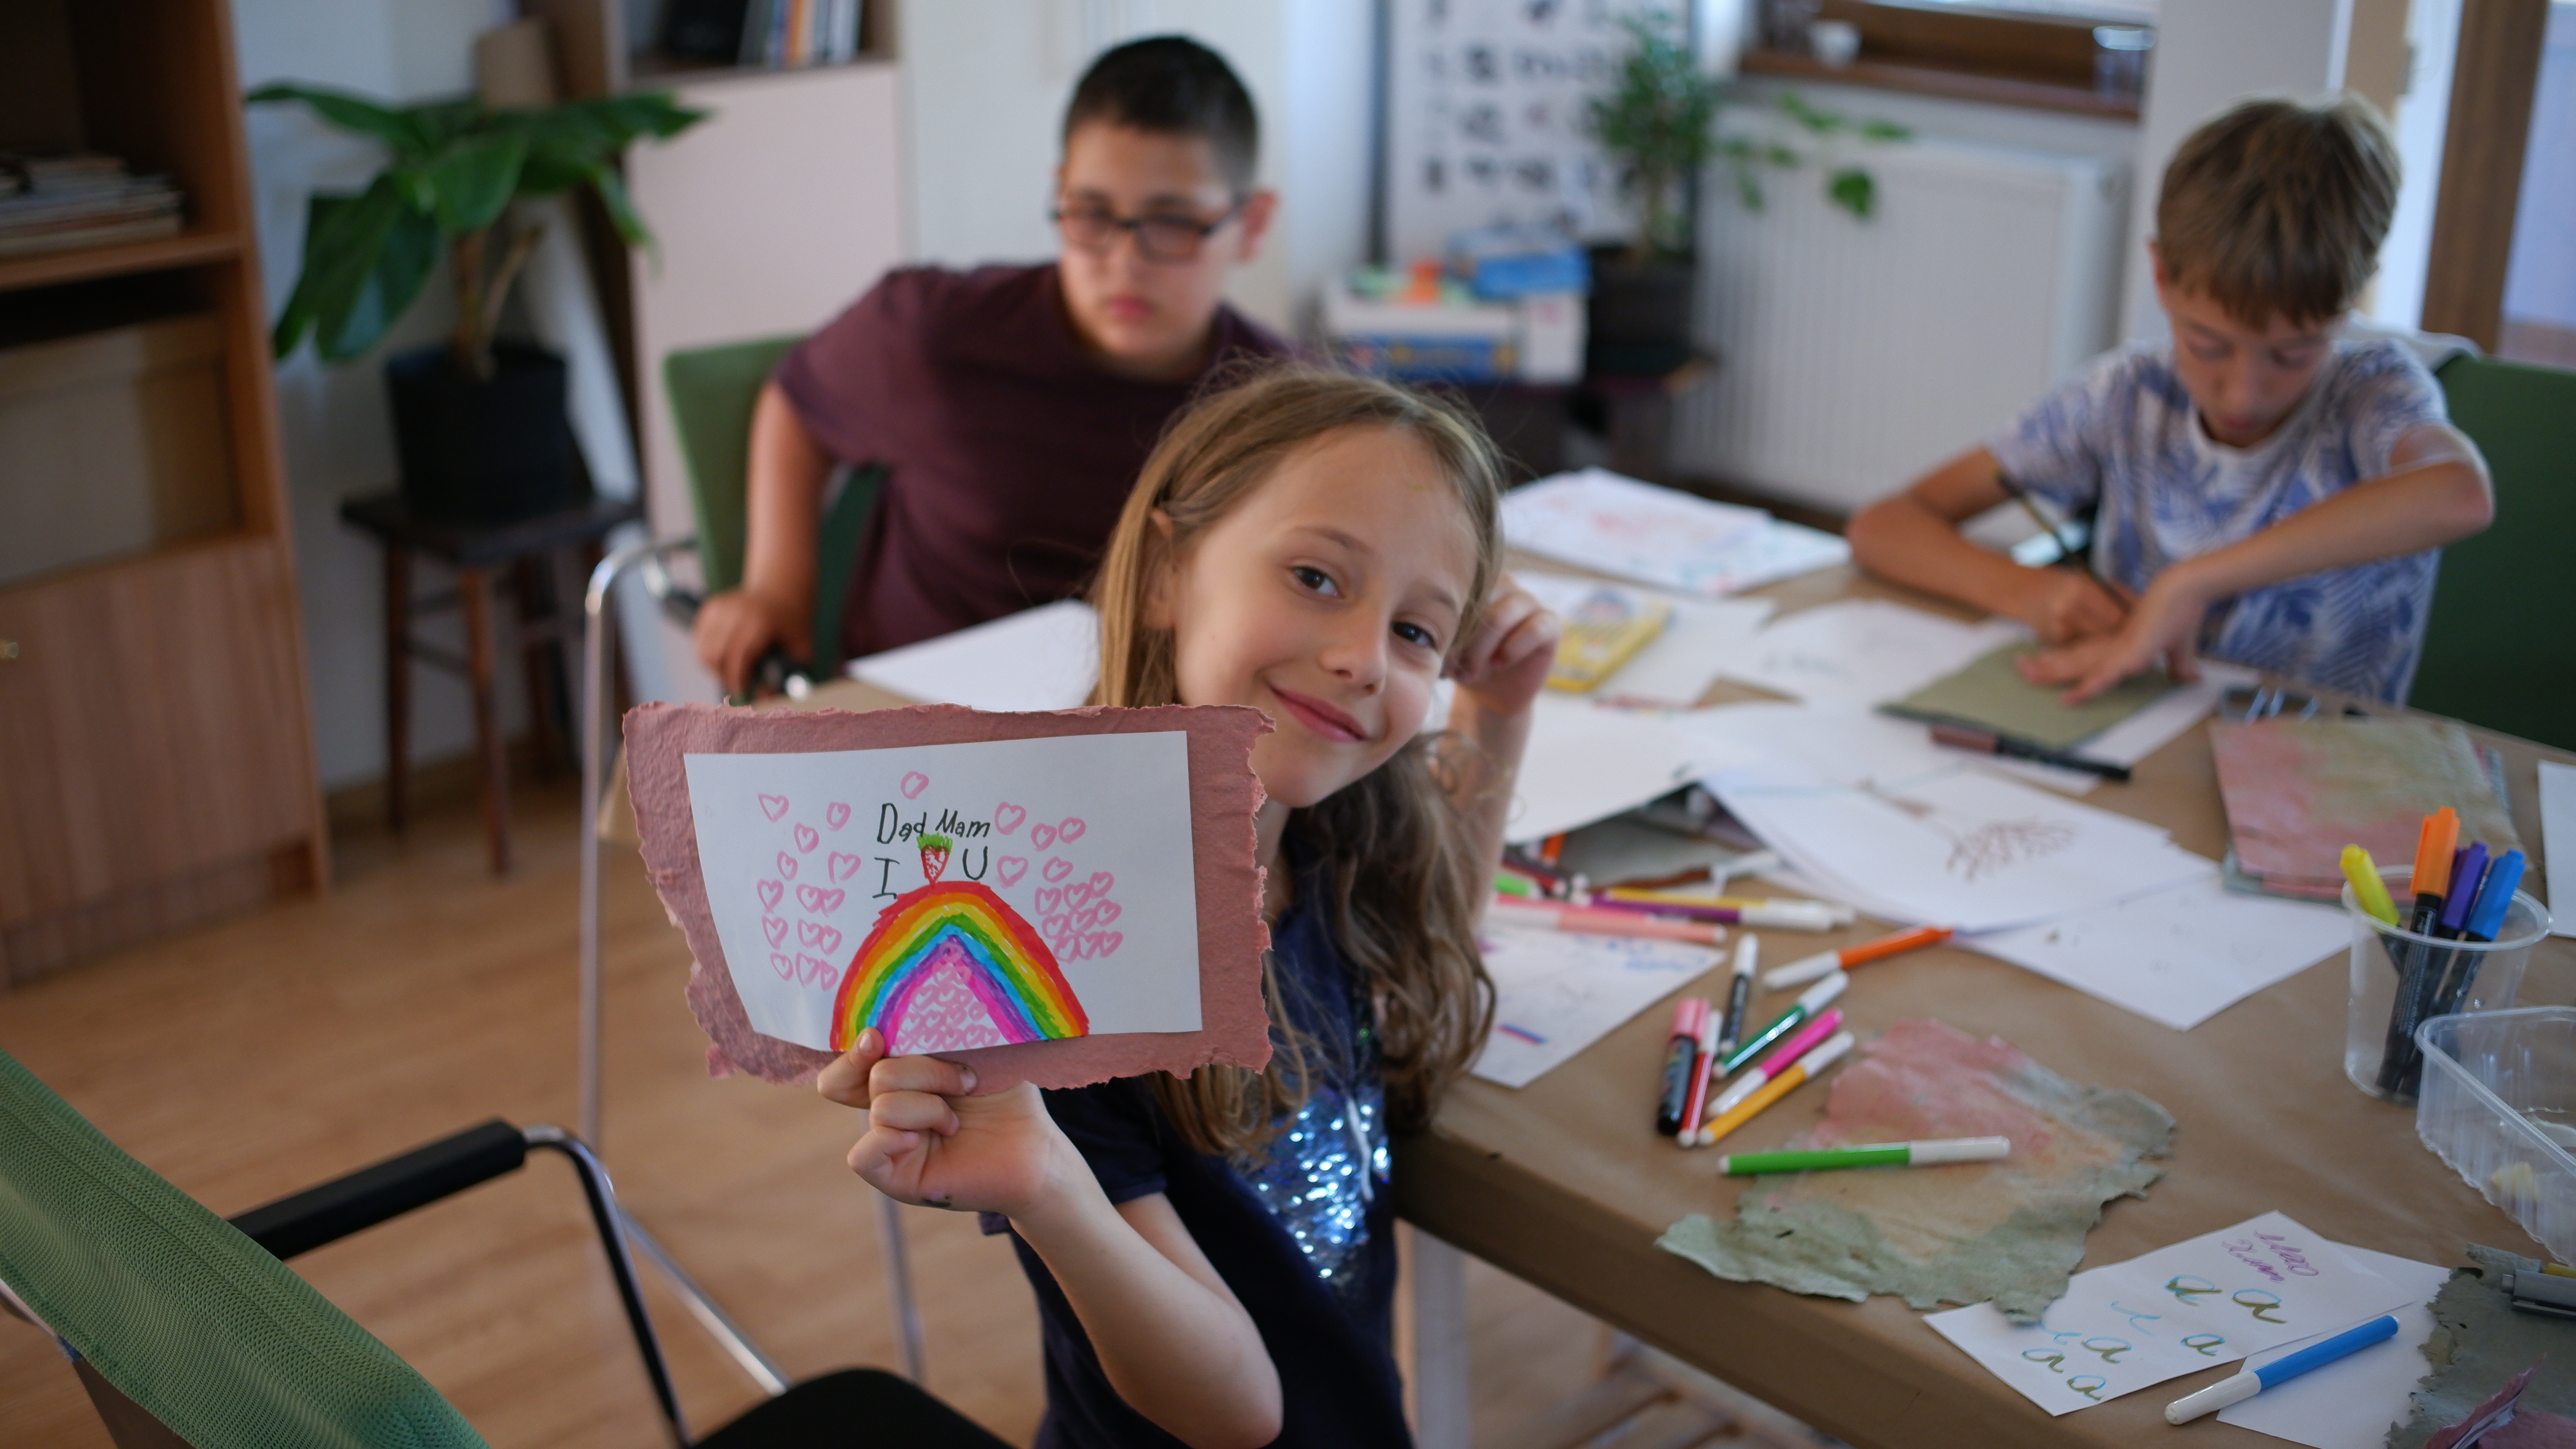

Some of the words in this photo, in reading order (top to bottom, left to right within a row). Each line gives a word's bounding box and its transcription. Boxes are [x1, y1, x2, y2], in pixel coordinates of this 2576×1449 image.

[877, 803, 927, 844] Dad
[935, 808, 990, 837] Mam
[872, 857, 900, 900] I
[962, 846, 988, 881] U
